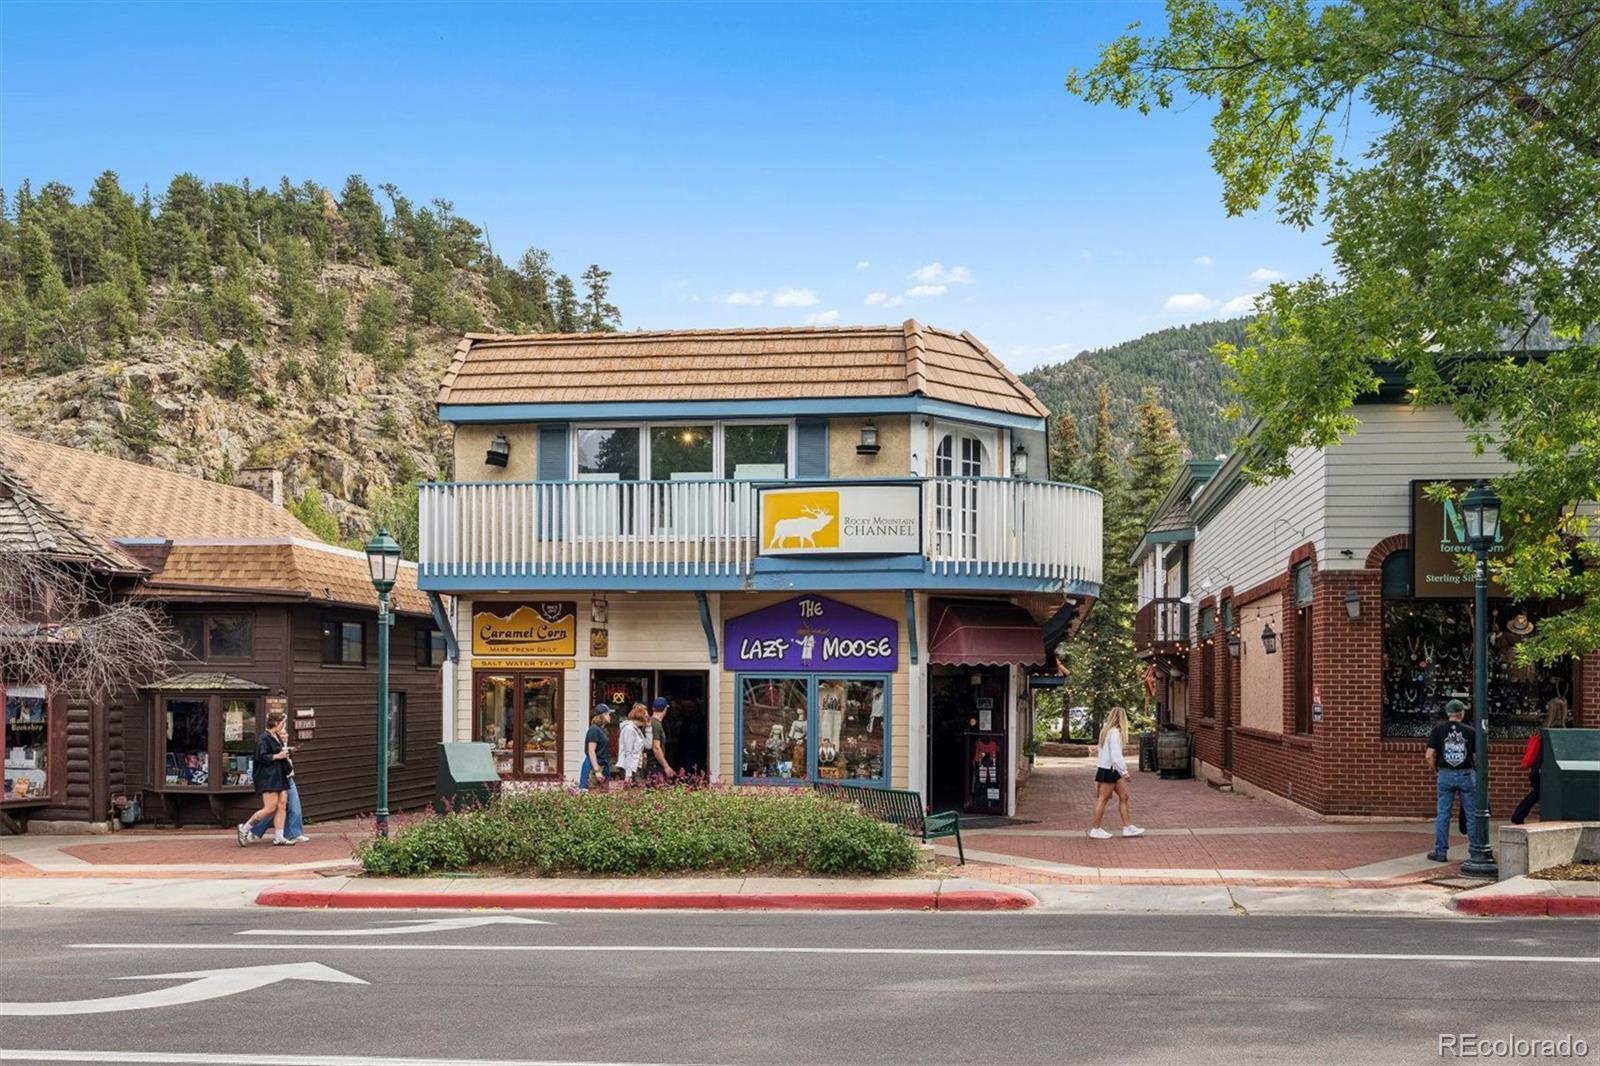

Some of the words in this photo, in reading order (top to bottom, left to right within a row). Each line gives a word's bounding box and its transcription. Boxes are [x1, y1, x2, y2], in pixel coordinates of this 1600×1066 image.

[844, 517, 870, 525] ROCKY
[873, 517, 915, 525] MOUNTAIN
[844, 526, 915, 536] CHANNEL
[1425, 574, 1460, 583] Sterling
[798, 599, 824, 617] THE
[480, 624, 533, 641] Caramel
[537, 624, 567, 639] Corn
[740, 638, 790, 660] LAZY
[823, 637, 892, 660] MOOSE
